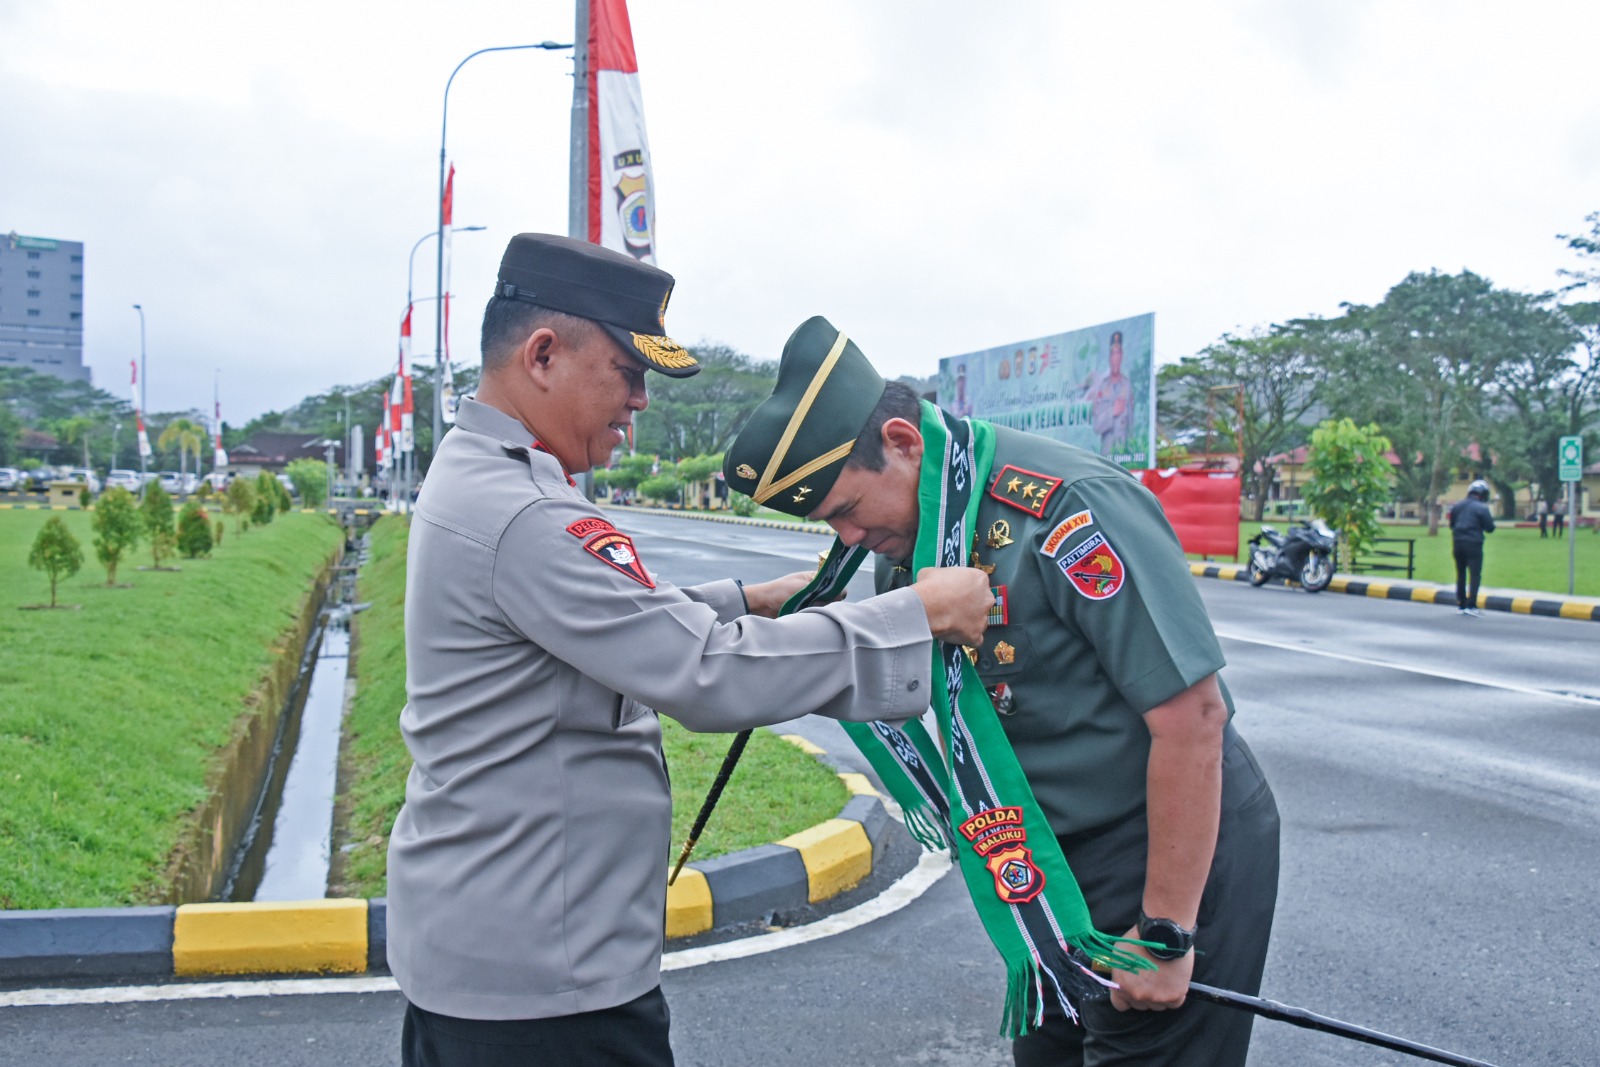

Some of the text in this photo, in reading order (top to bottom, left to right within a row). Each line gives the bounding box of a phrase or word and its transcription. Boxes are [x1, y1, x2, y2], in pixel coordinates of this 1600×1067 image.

[1031, 481, 1055, 509] TNI
[1044, 514, 1088, 554] SKODAM XVI
[1061, 536, 1102, 568] PATTIMURA
[965, 809, 1018, 835] POLDA
[978, 830, 1022, 852] MALUKU
